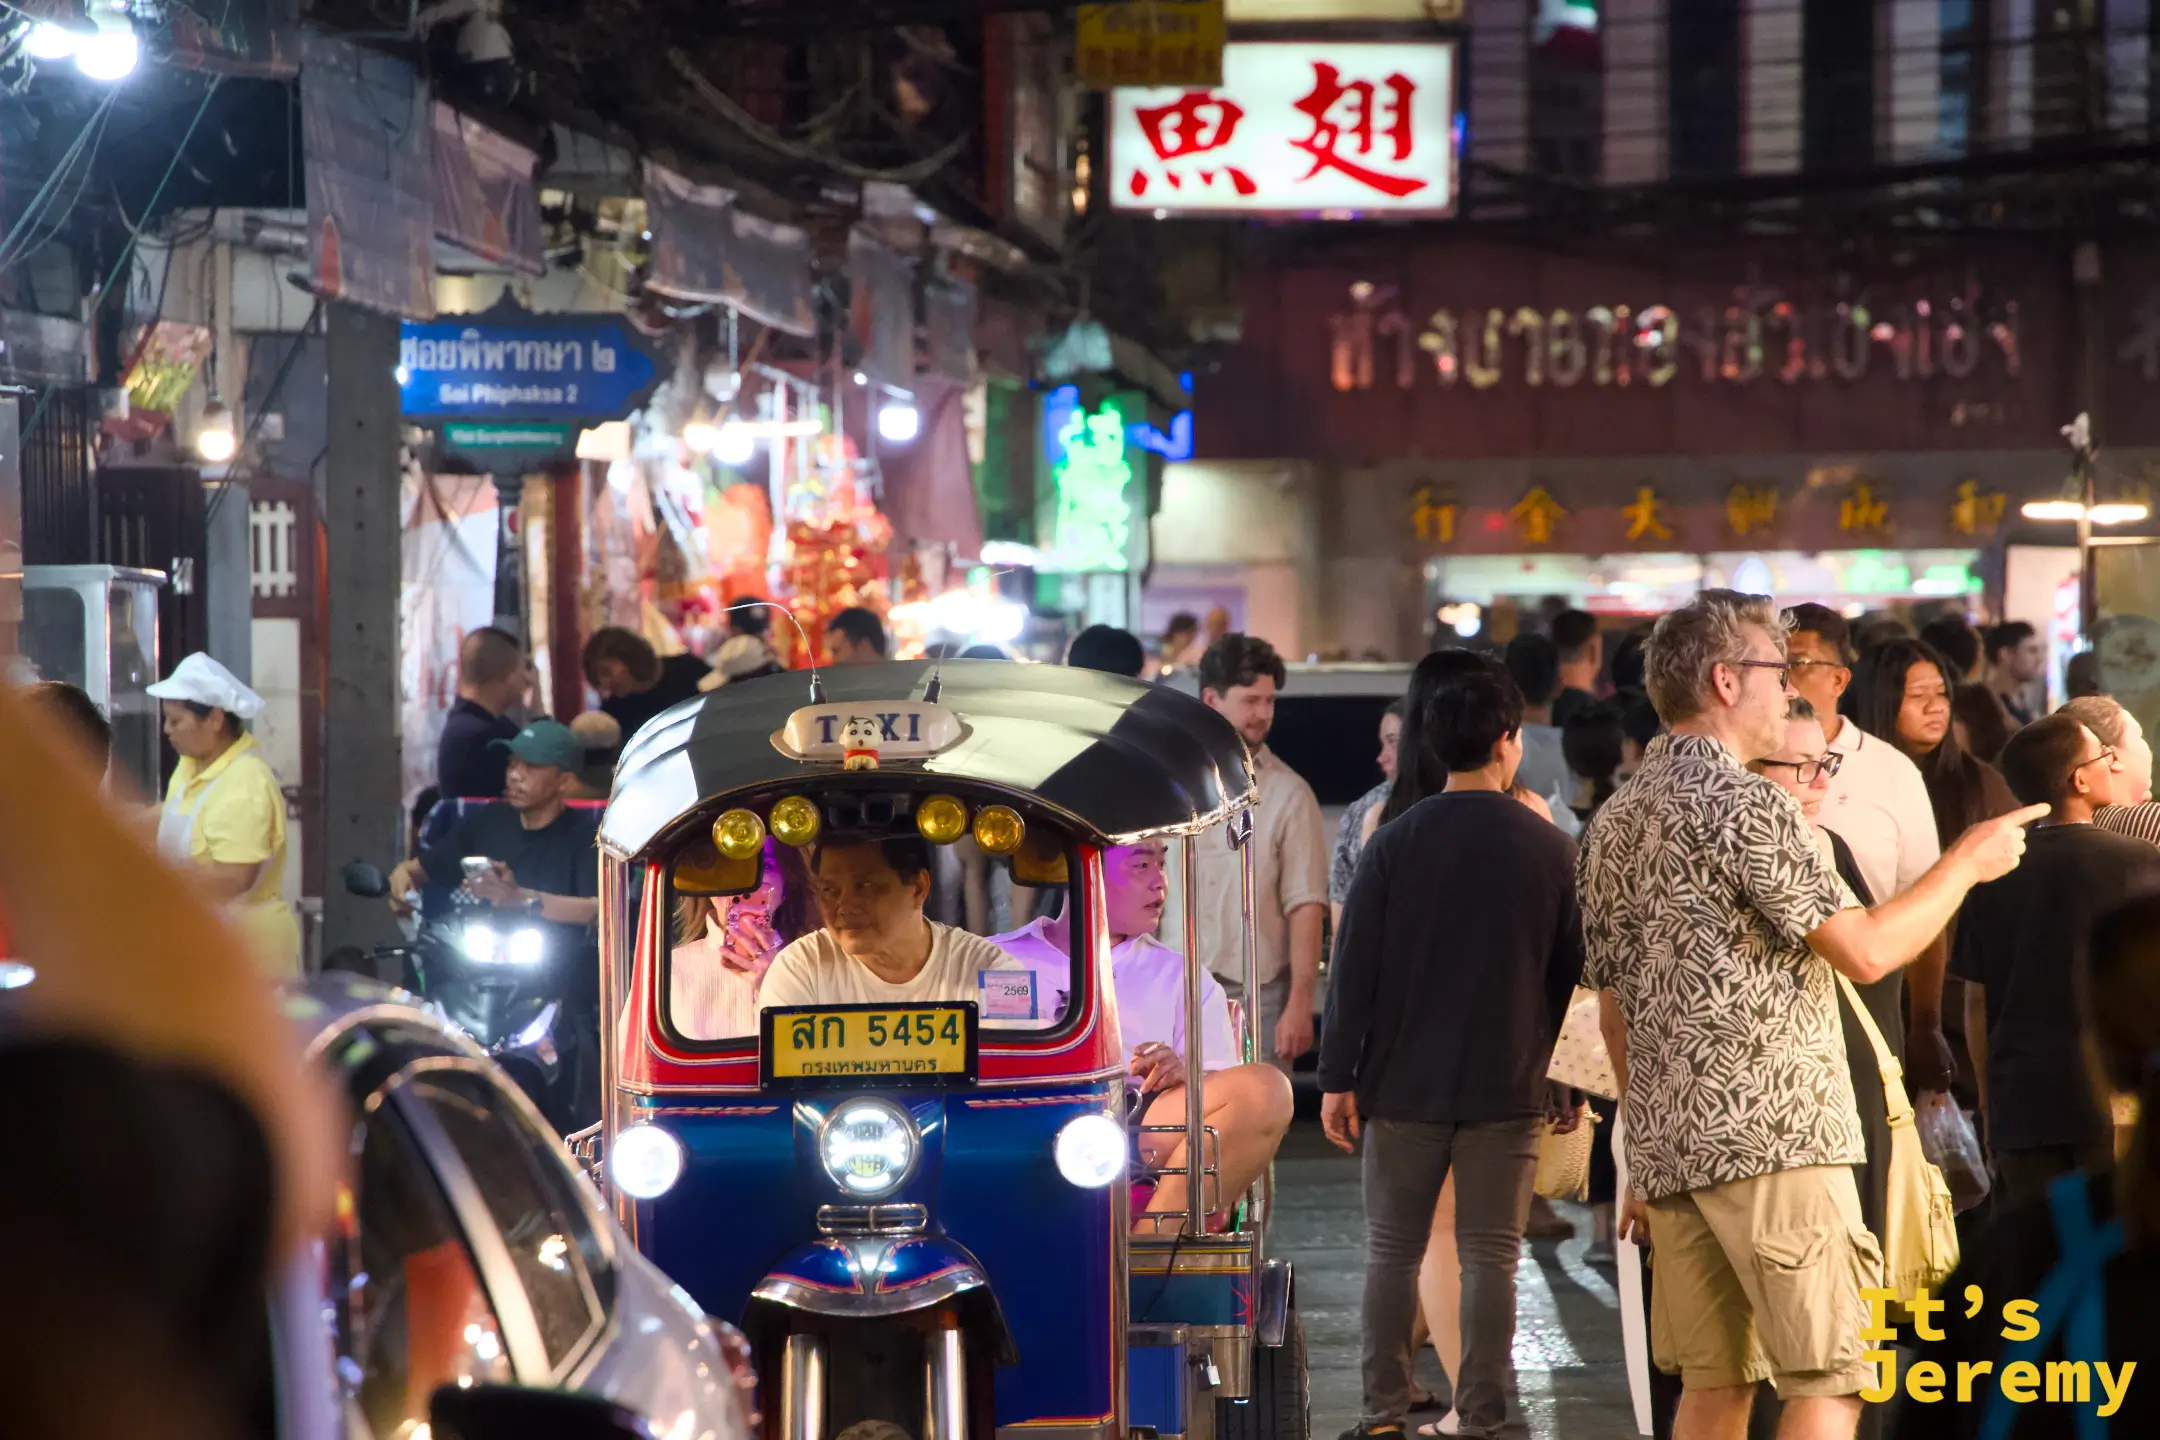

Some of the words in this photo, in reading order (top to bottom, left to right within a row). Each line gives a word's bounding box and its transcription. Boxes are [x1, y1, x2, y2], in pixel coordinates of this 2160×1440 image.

[1130, 61, 1428, 197] 魚翅
[439, 383, 469, 404] Soi
[566, 384, 579, 403] 2
[815, 713, 921, 743] TXI
[1004, 985, 1029, 996] 2569
[792, 1015, 845, 1050] สก
[868, 1013, 960, 1047] 5454
[802, 1058, 938, 1075] กรงเทพมหานคร
